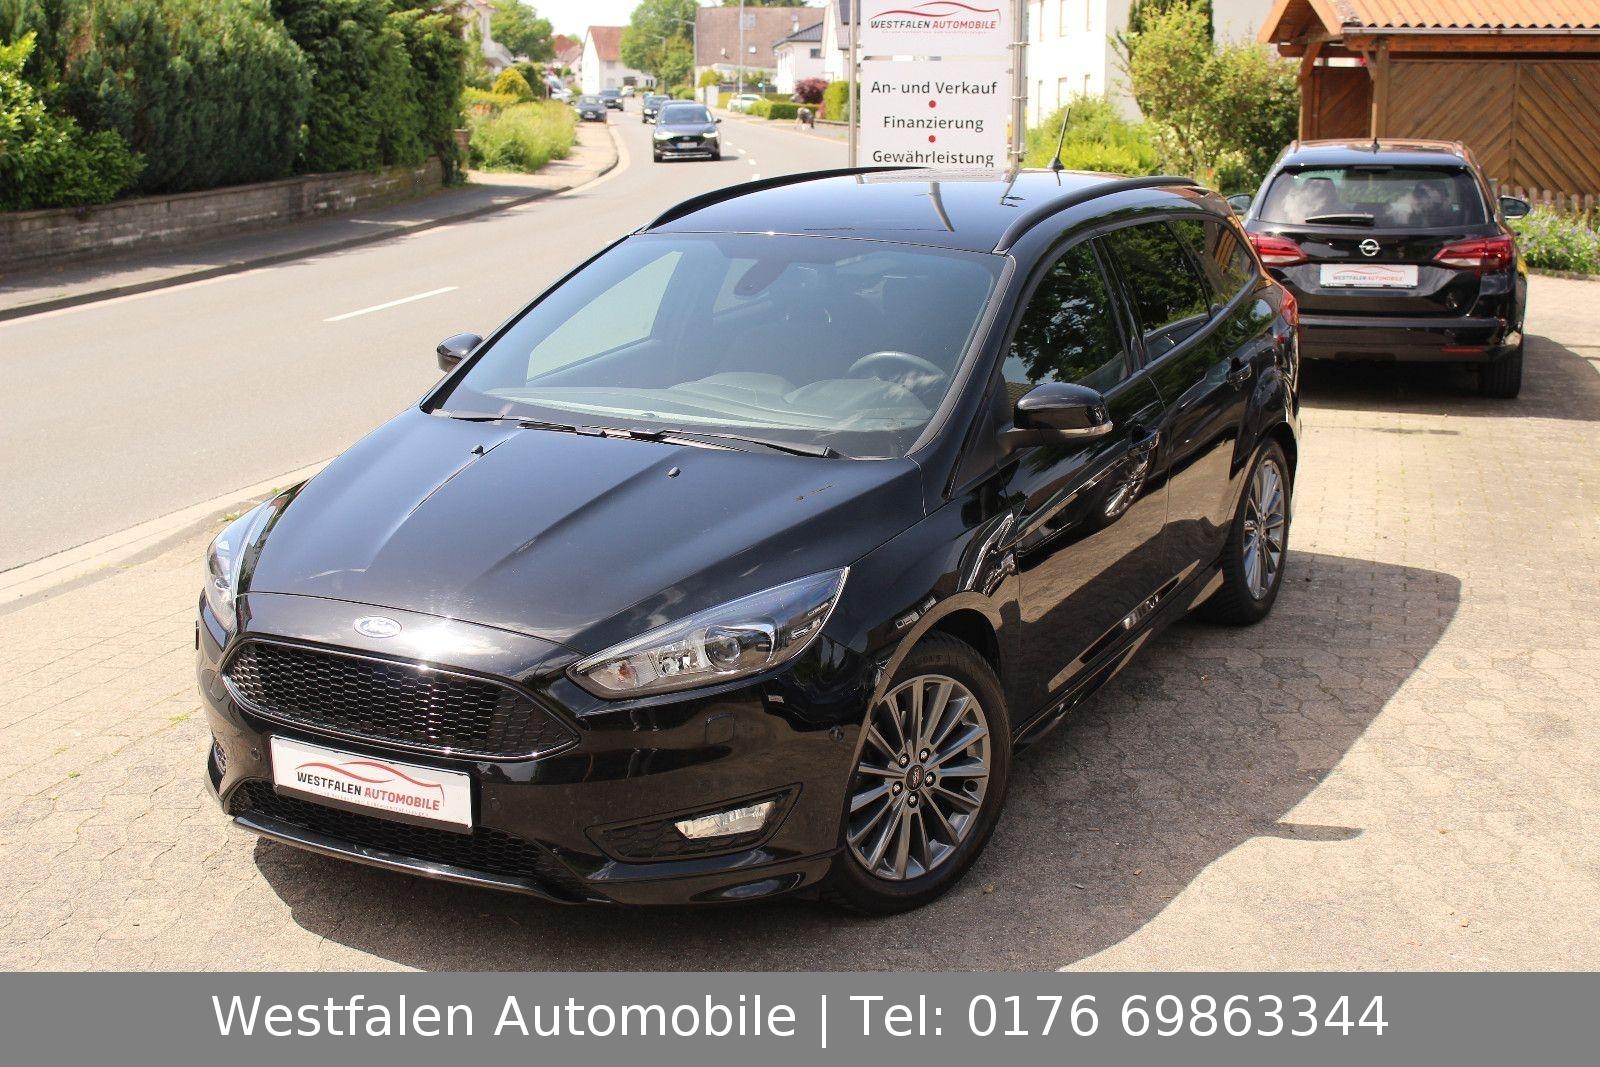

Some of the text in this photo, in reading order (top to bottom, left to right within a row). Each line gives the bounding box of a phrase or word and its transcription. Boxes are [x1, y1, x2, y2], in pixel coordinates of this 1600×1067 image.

[870, 20, 997, 29] WESTFALEN AUTOMOBILE
[871, 81, 998, 95] An- und Verkauf
[883, 116, 984, 132] Finanzierung
[873, 150, 994, 168] Gewährleistung
[297, 771, 362, 796] WESTFALEN
[363, 787, 441, 811] AUTOMOBILE
